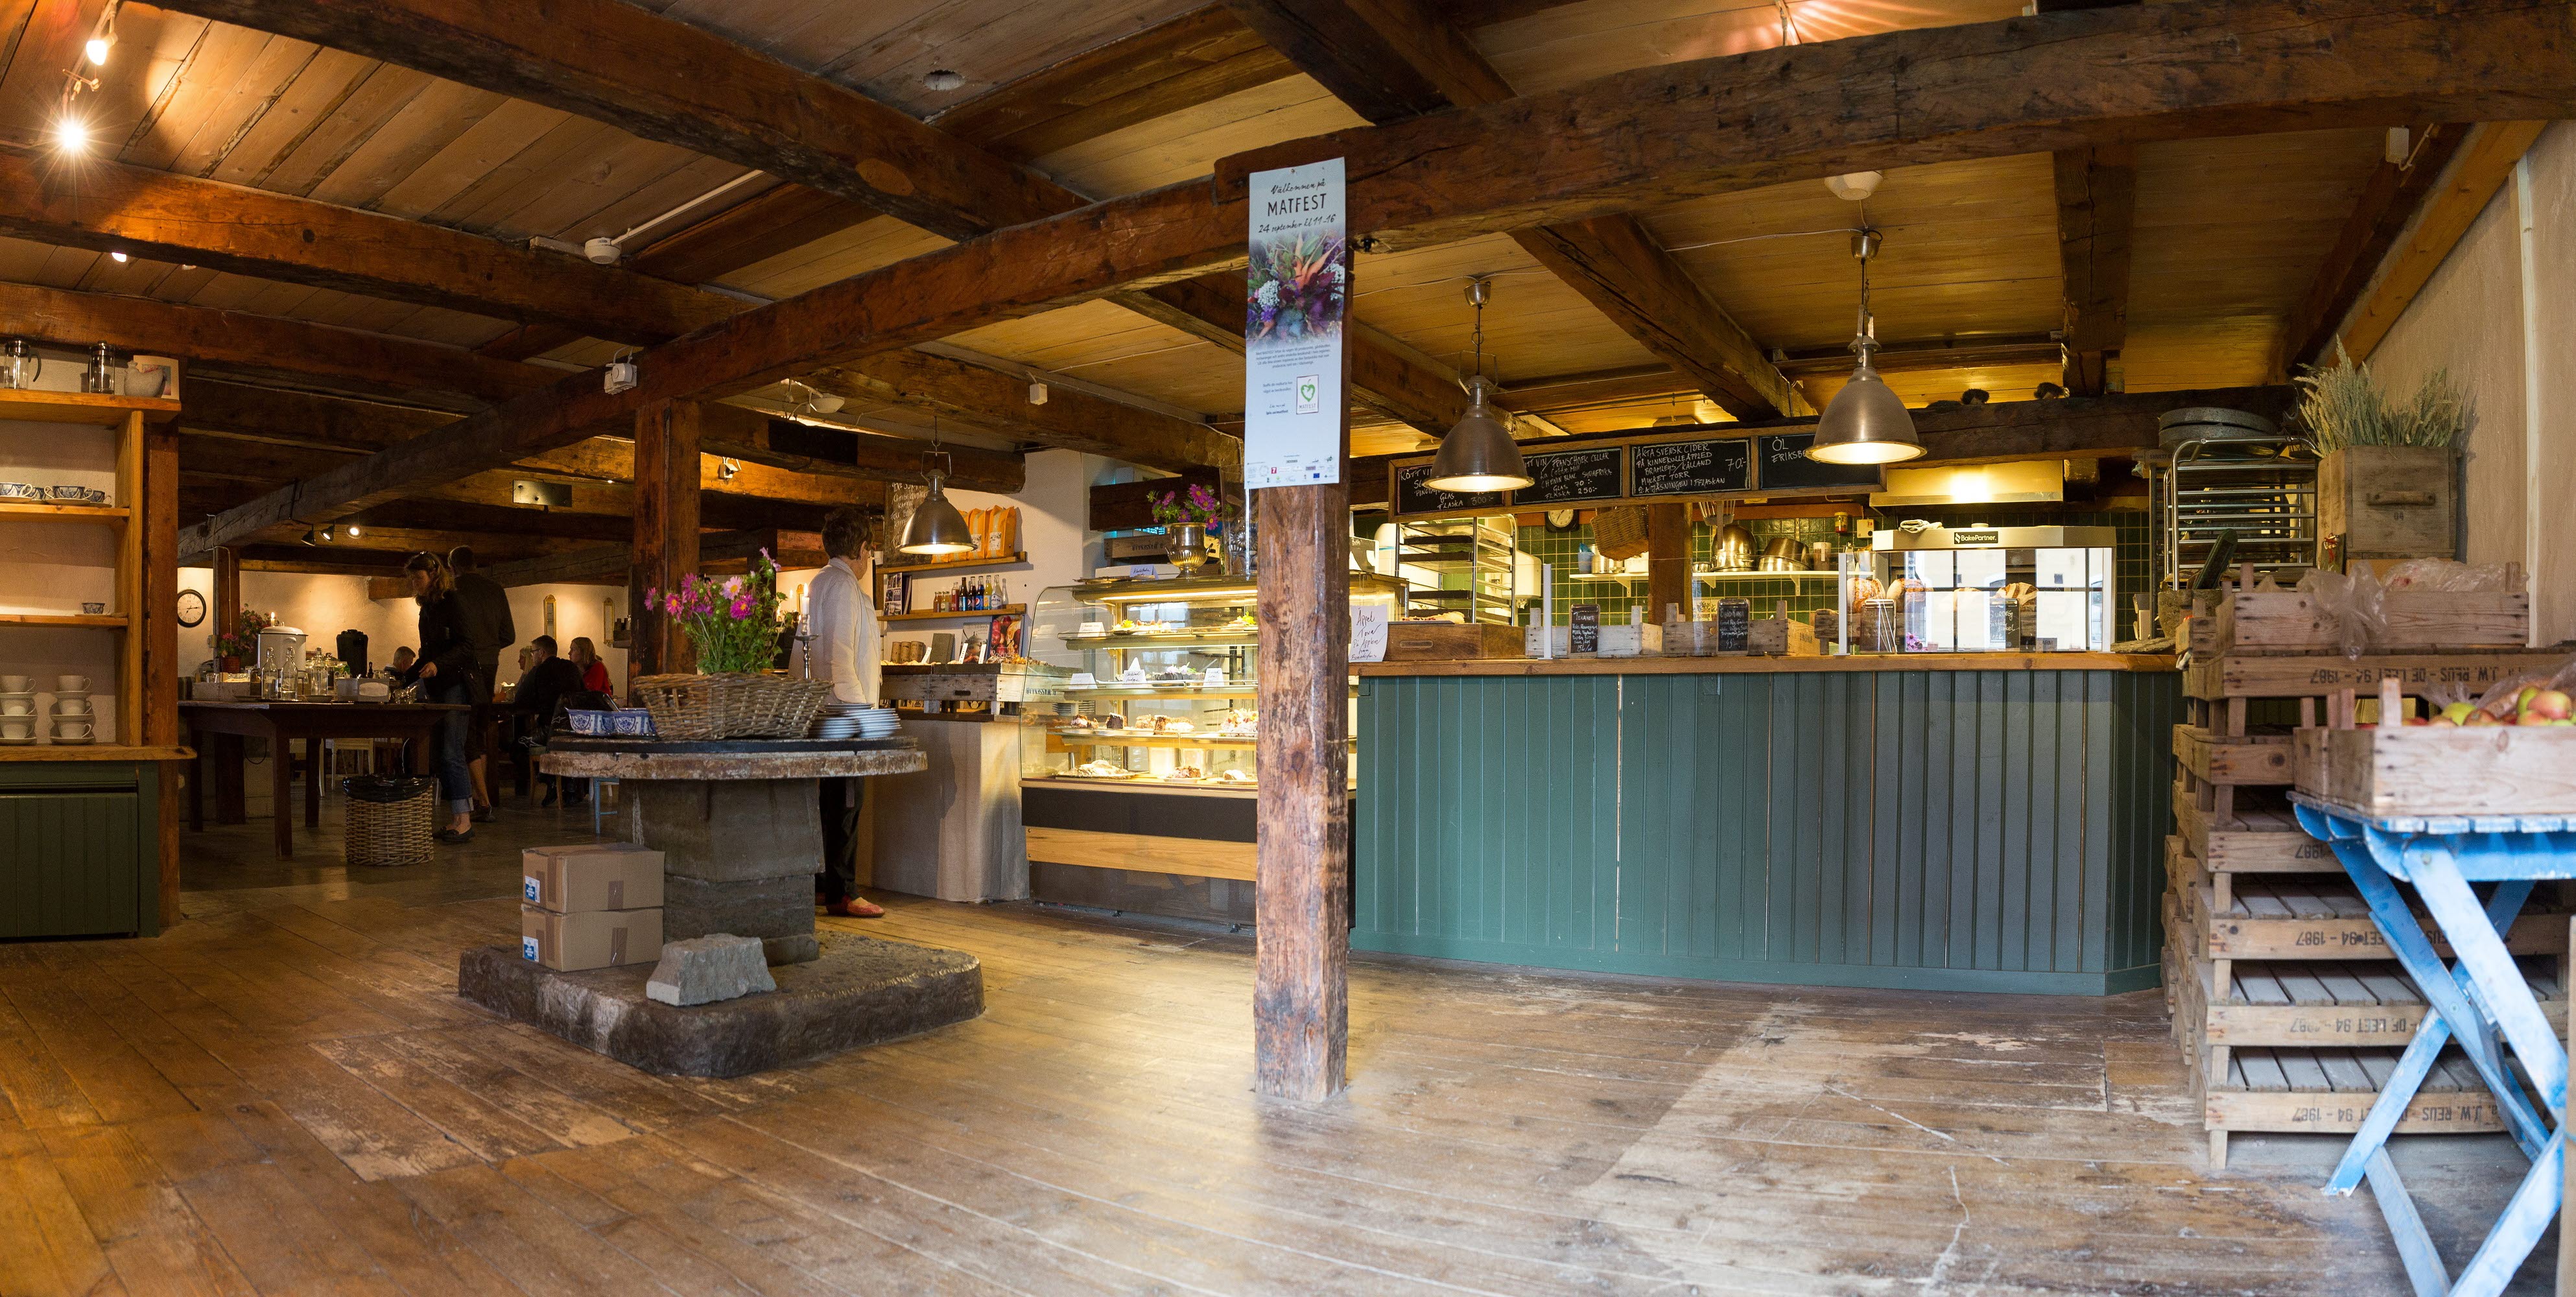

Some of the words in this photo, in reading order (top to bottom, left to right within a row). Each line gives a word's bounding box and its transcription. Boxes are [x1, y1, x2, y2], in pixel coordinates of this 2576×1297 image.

[1270, 182, 1316, 195] Välkommen
[1316, 178, 1326, 191] på
[1268, 193, 1327, 217] MATFEST
[1258, 224, 1270, 233] 24
[1271, 219, 1303, 233] september
[1304, 215, 1312, 226] kl
[1591, 452, 1609, 462] CELLAR
[1657, 446, 1683, 457] SVENSK
[1684, 444, 1710, 454] CIDER
[1423, 468, 1432, 477] VI
[1541, 477, 1562, 488] CHENIN
[1564, 473, 1576, 482] BLANC
[1582, 468, 1613, 479] SYDAFRIKA
[1641, 474, 1666, 485] MYCKET
[1440, 492, 1454, 503] GLAS
[1544, 490, 1570, 499] FLASKA
[1437, 500, 1463, 510] FLASKA
[2310, 668, 2339, 684] 1987
[2411, 668, 2426, 682] DE
[2440, 667, 2470, 682] REUS
[2295, 844, 2324, 859] 1987
[2296, 931, 2326, 946] 1987
[2341, 931, 2356, 946] 94
[2364, 931, 2385, 946] EET
[2335, 1018, 2351, 1032] 94
[2356, 1018, 2387, 1032] LEET
[2292, 1108, 2322, 1122] 1987
[2337, 1108, 2353, 1122] 94
[2422, 1107, 2452, 1121] REUS
